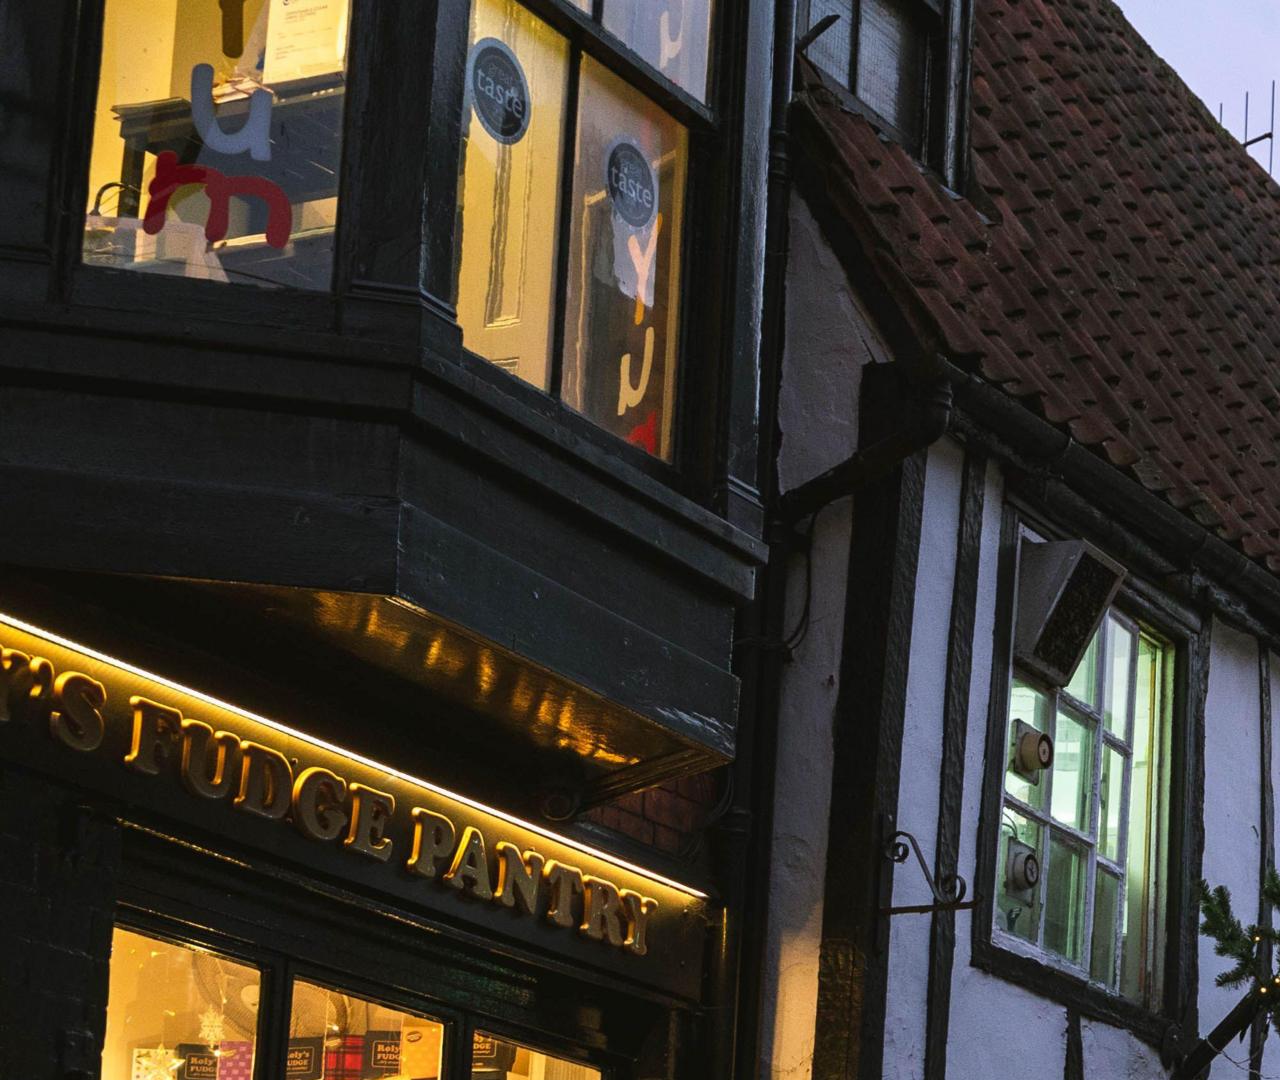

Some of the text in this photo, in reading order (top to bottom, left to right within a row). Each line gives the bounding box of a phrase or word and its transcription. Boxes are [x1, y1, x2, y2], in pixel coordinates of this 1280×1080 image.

[477, 68, 522, 118] taste
[612, 166, 652, 208] taste
[124, 695, 396, 861] FUDGE
[407, 807, 658, 955] PANTRY
